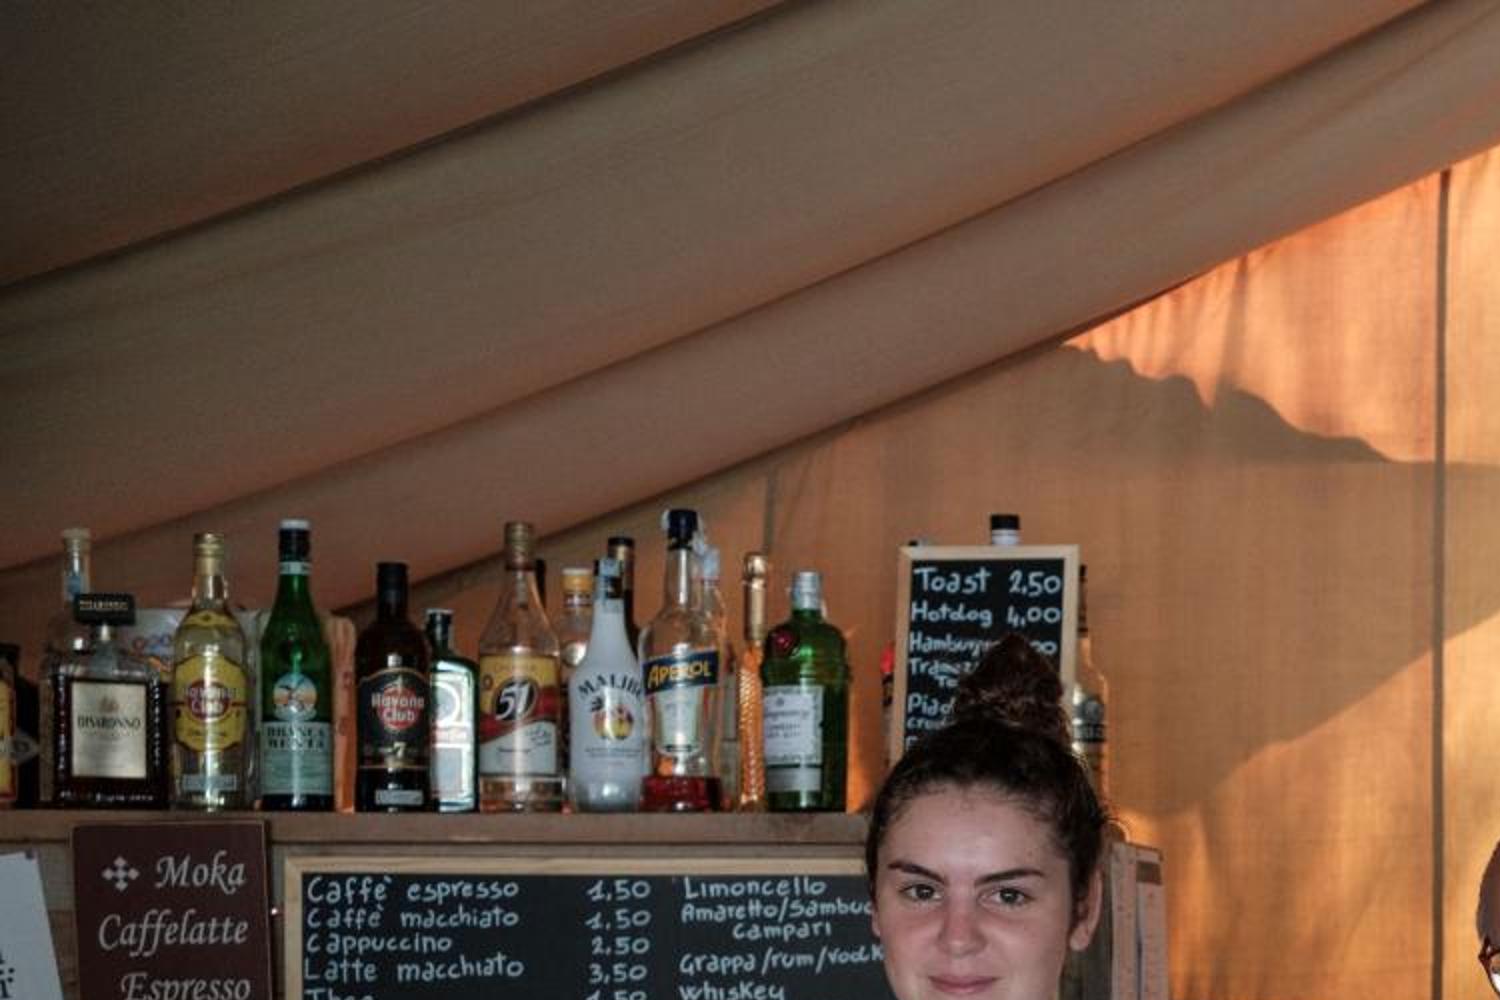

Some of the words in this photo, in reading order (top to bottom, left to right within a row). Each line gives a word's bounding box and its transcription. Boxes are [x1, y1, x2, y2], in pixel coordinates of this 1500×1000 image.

[914, 567, 991, 593] Toast
[1009, 570, 1063, 597] 2,50
[911, 602, 992, 628] Hotdog
[1007, 605, 1062, 628] 4,00
[648, 660, 711, 688] APEROL
[495, 681, 532, 720] 51
[155, 851, 246, 894] Moka
[407, 881, 520, 905] espresso
[586, 880, 651, 901] 1,50
[684, 876, 827, 899] Limoncello
[400, 904, 520, 928] macchiato
[584, 908, 652, 930] 1,50
[99, 909, 249, 957] Caffelatte
[307, 932, 453, 955] Cappuccino
[304, 958, 377, 983] Latte
[397, 952, 525, 982] macchiato
[589, 962, 648, 985] 3,50
